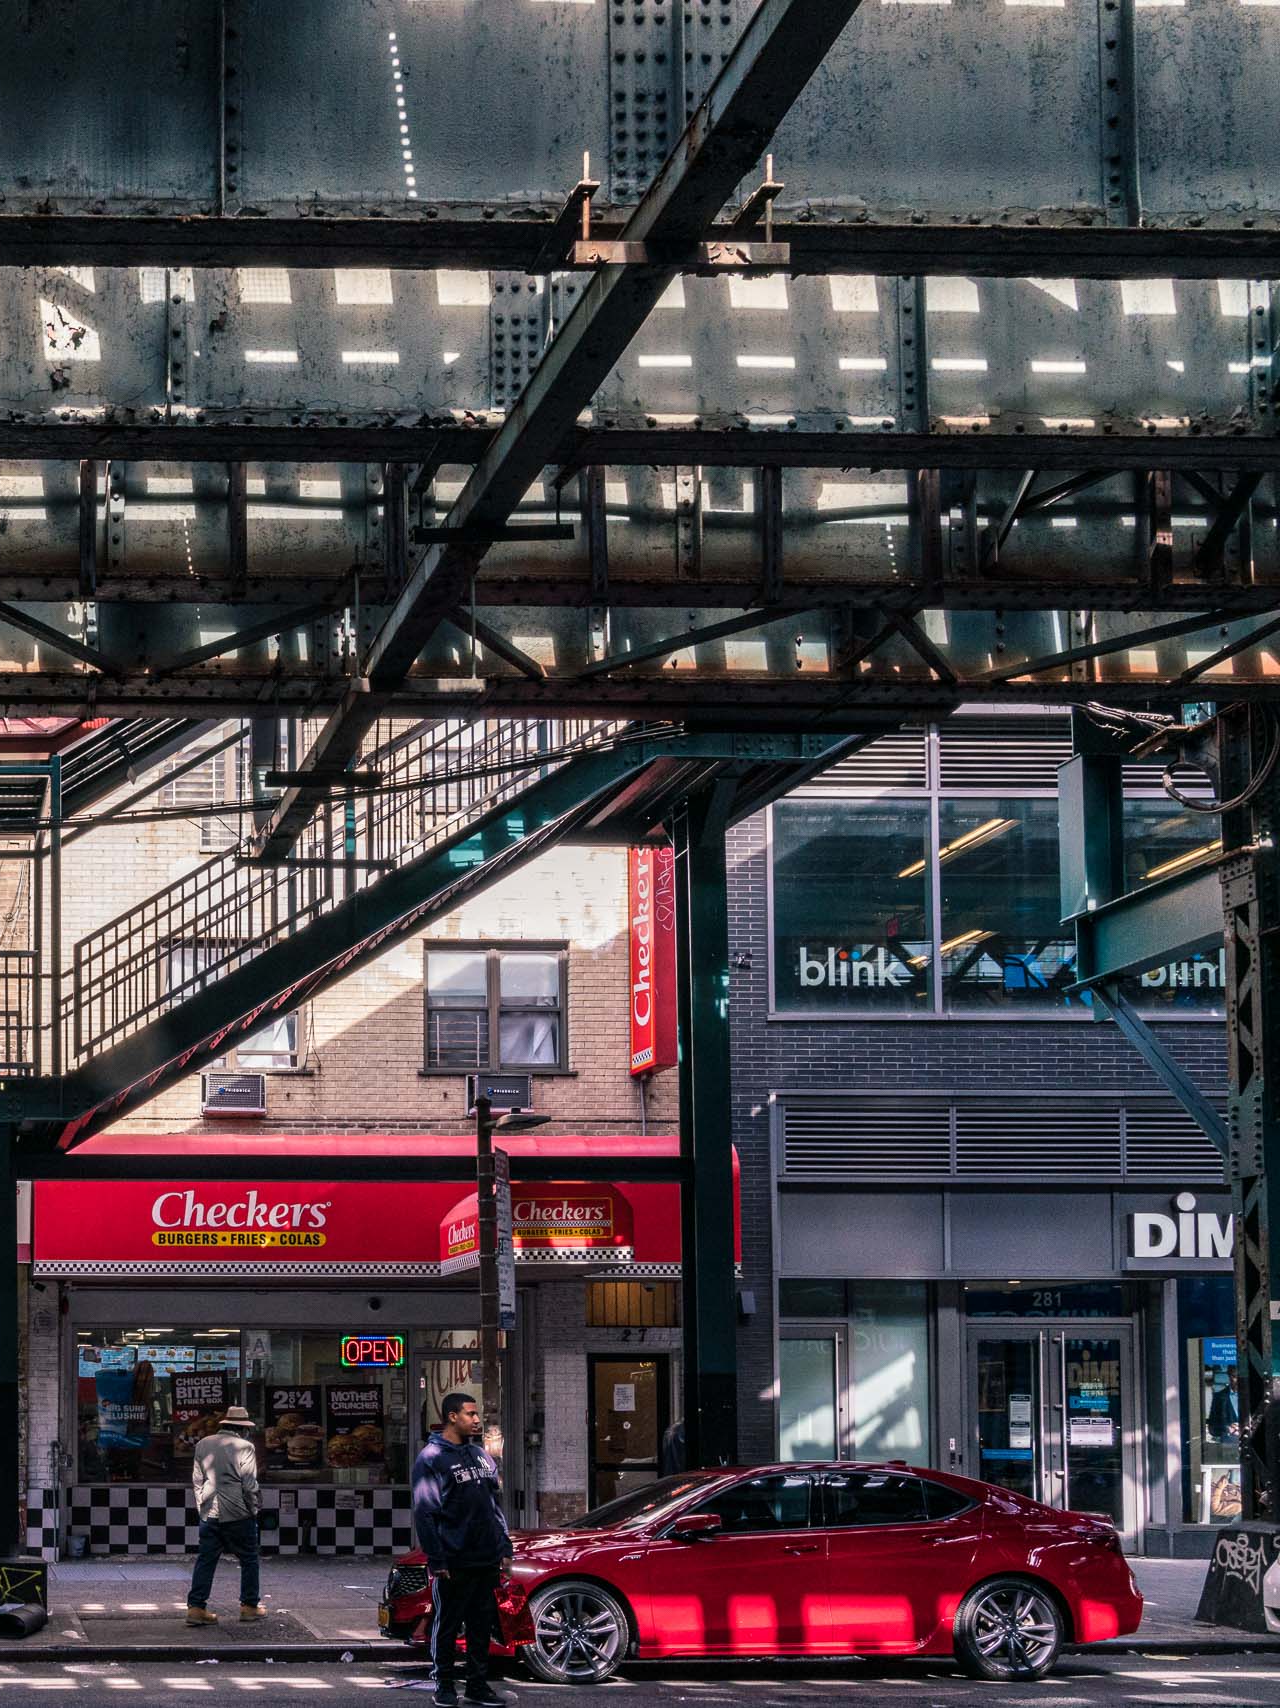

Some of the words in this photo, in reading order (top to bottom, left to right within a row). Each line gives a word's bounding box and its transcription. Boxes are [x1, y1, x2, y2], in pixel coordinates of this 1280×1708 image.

[800, 947, 902, 986] blink
[151, 1190, 328, 1228] Checkers
[513, 1200, 605, 1221] Checkers
[158, 1233, 218, 1245] BURGERS
[230, 1233, 267, 1245] FRIES
[279, 1233, 321, 1245] COLAS
[1032, 1291, 1061, 1307] 281
[345, 1341, 399, 1362] OPEN
[175, 1376, 223, 1387] CHICKEN
[175, 1385, 223, 1399] BITES
[330, 1390, 378, 1402] MOTHER
[331, 1401, 378, 1410] CRUNCHER
